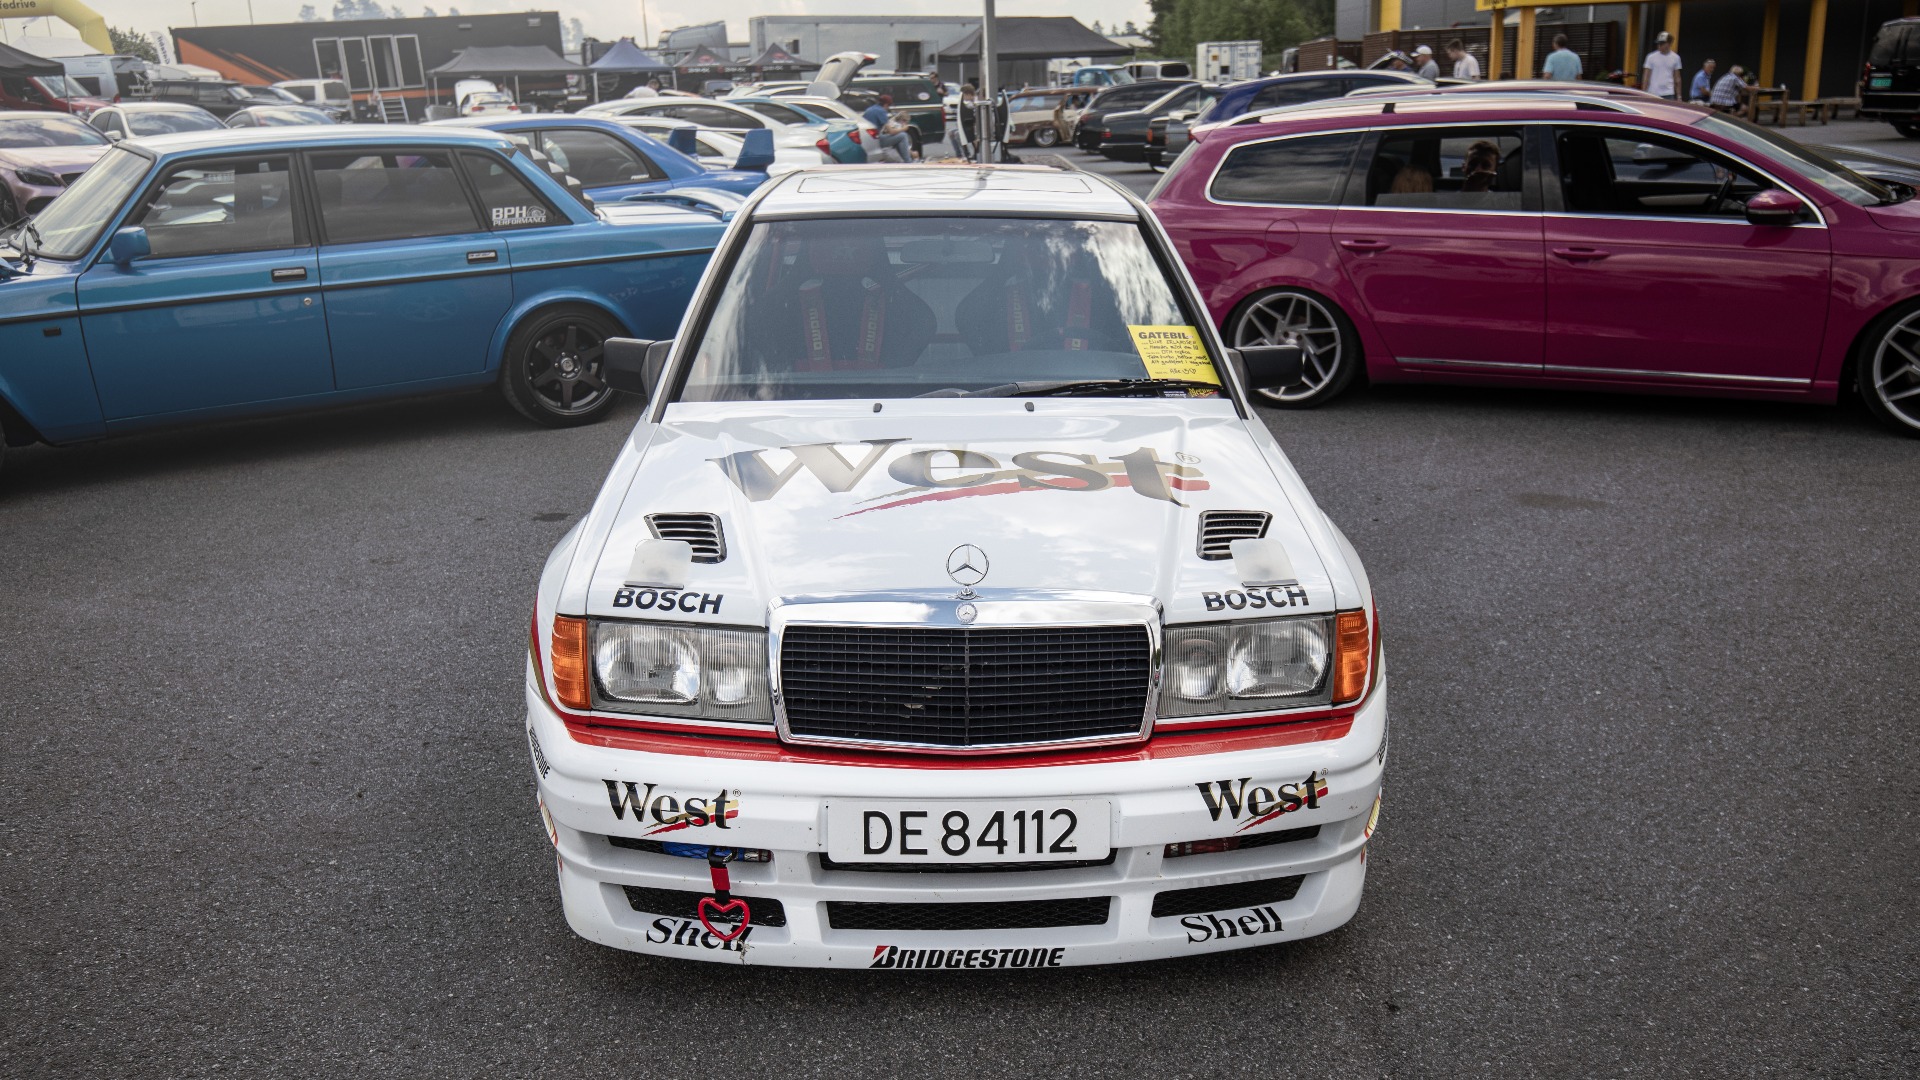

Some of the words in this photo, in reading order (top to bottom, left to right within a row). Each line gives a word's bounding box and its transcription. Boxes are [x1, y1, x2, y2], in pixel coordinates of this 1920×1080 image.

[492, 206, 527, 221] BPH
[493, 216, 547, 226] PERFORMANCE
[705, 438, 1190, 508] West
[613, 588, 723, 614] BOSCH
[1205, 586, 1309, 613] BOSCH
[602, 779, 732, 830] West
[1195, 770, 1322, 822] West
[862, 810, 928, 855] DE
[940, 808, 1078, 856] 84112
[1180, 906, 1284, 944] Shell
[869, 945, 1065, 969] BRIDGESTONE
